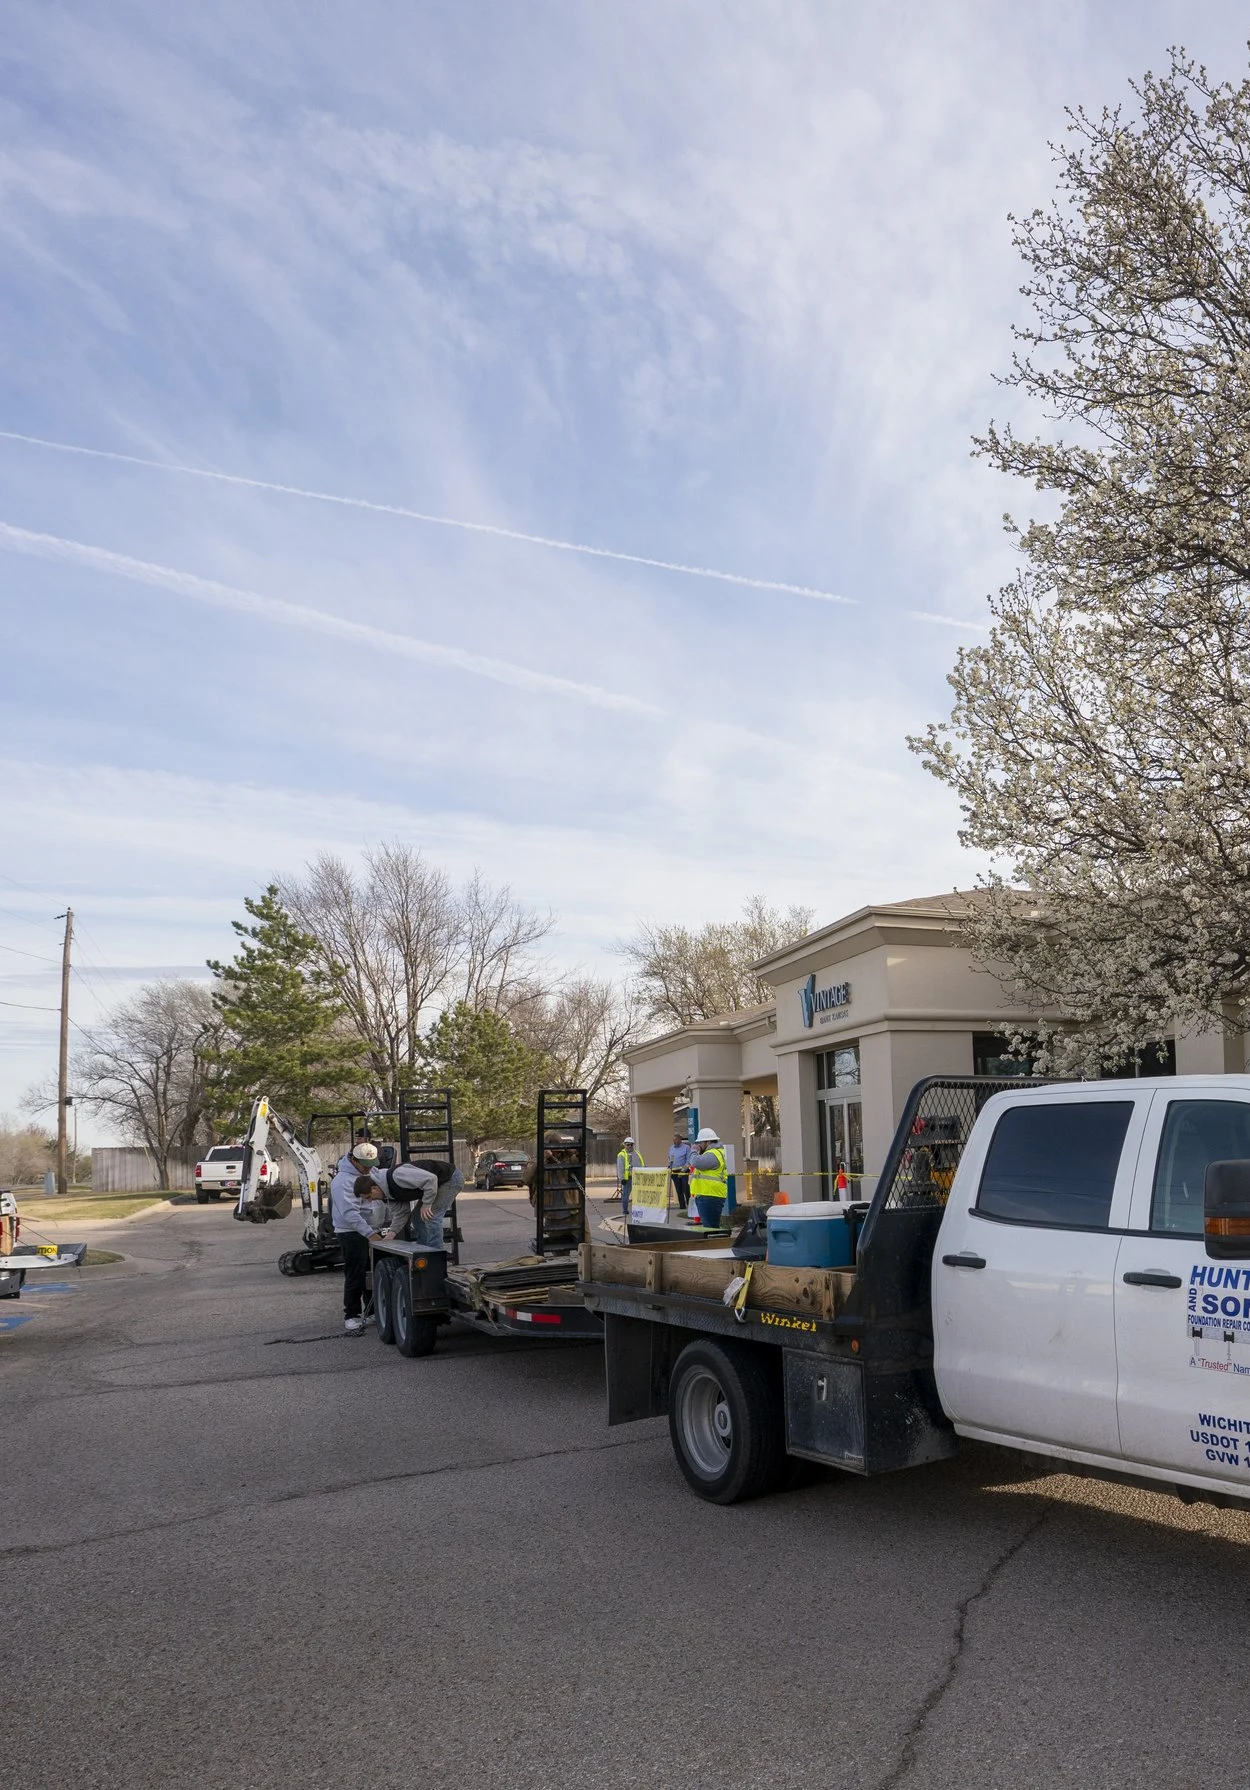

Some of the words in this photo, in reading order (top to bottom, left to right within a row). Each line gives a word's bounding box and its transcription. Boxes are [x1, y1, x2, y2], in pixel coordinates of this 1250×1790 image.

[811, 982, 850, 1012] VINTAGE
[1188, 1288, 1197, 1312] AND
[761, 1312, 817, 1332] Winkel
[1188, 1315, 1221, 1327] FOUNDATION
[1222, 1319, 1241, 1331] REPAIR
[1190, 1357, 1196, 1366] A
[1198, 1358, 1232, 1371] "Trusted"
[1190, 1430, 1239, 1450] USDOT
[1206, 1449, 1239, 1465] GVW
